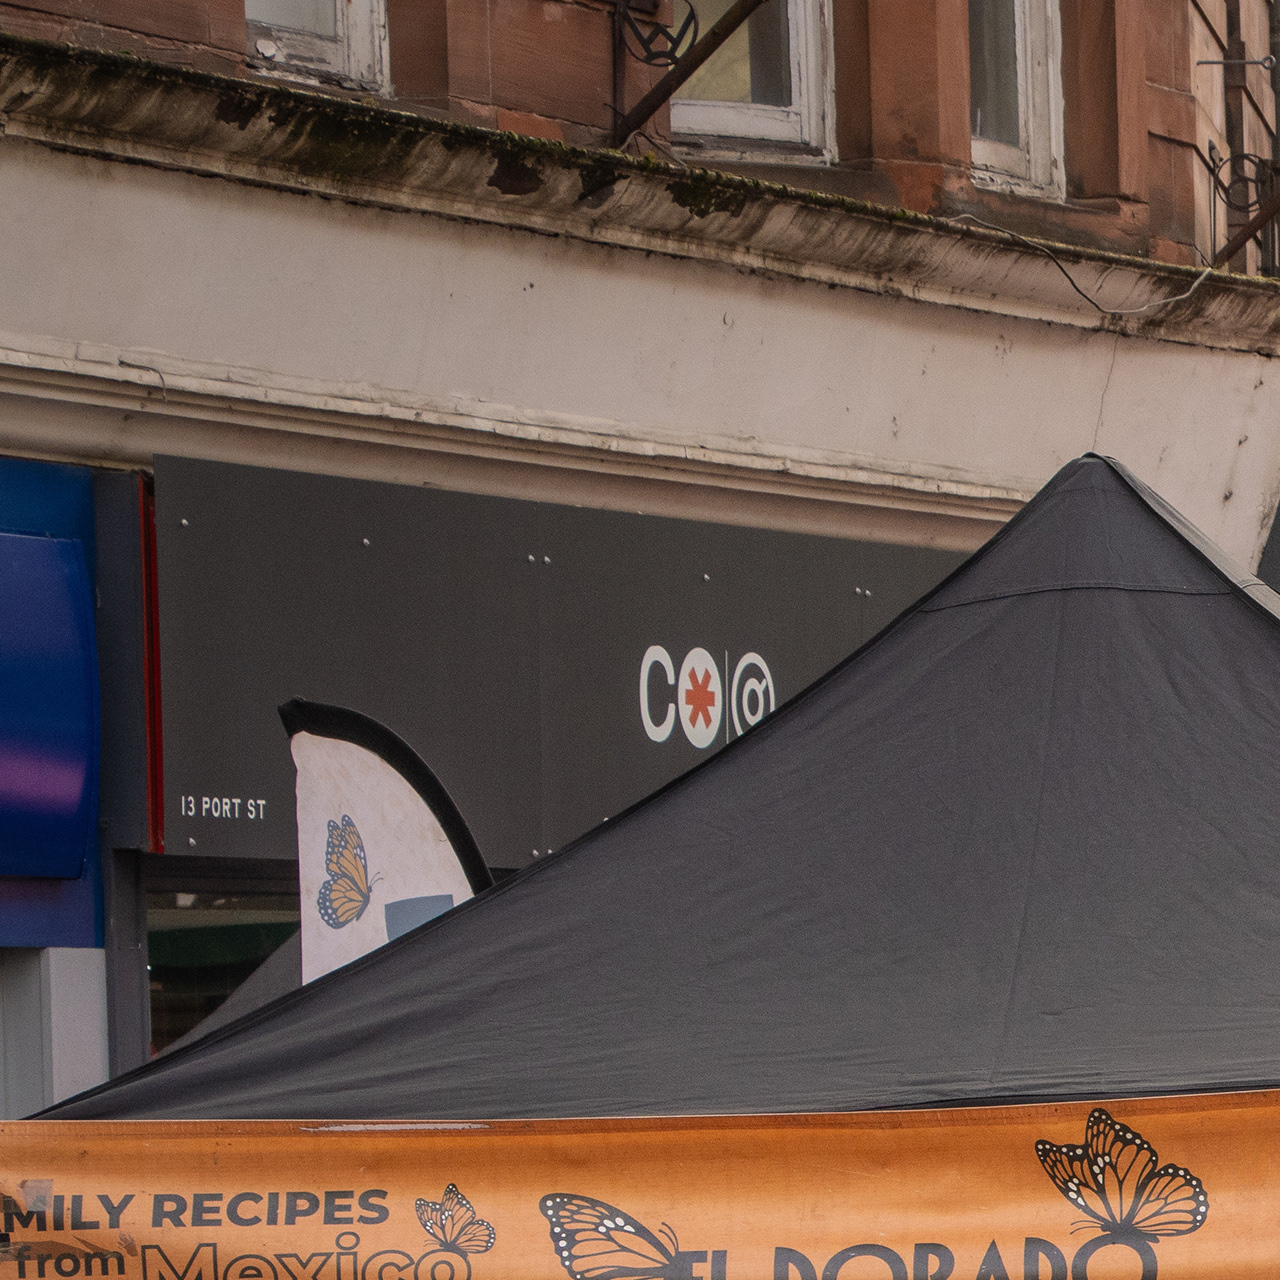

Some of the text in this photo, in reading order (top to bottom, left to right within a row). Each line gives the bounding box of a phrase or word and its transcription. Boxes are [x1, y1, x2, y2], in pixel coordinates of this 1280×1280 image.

[181, 796, 266, 820] 13 PORT ST
[3, 1189, 389, 1233] MILY RECIPES
[15, 1246, 126, 1279] from
